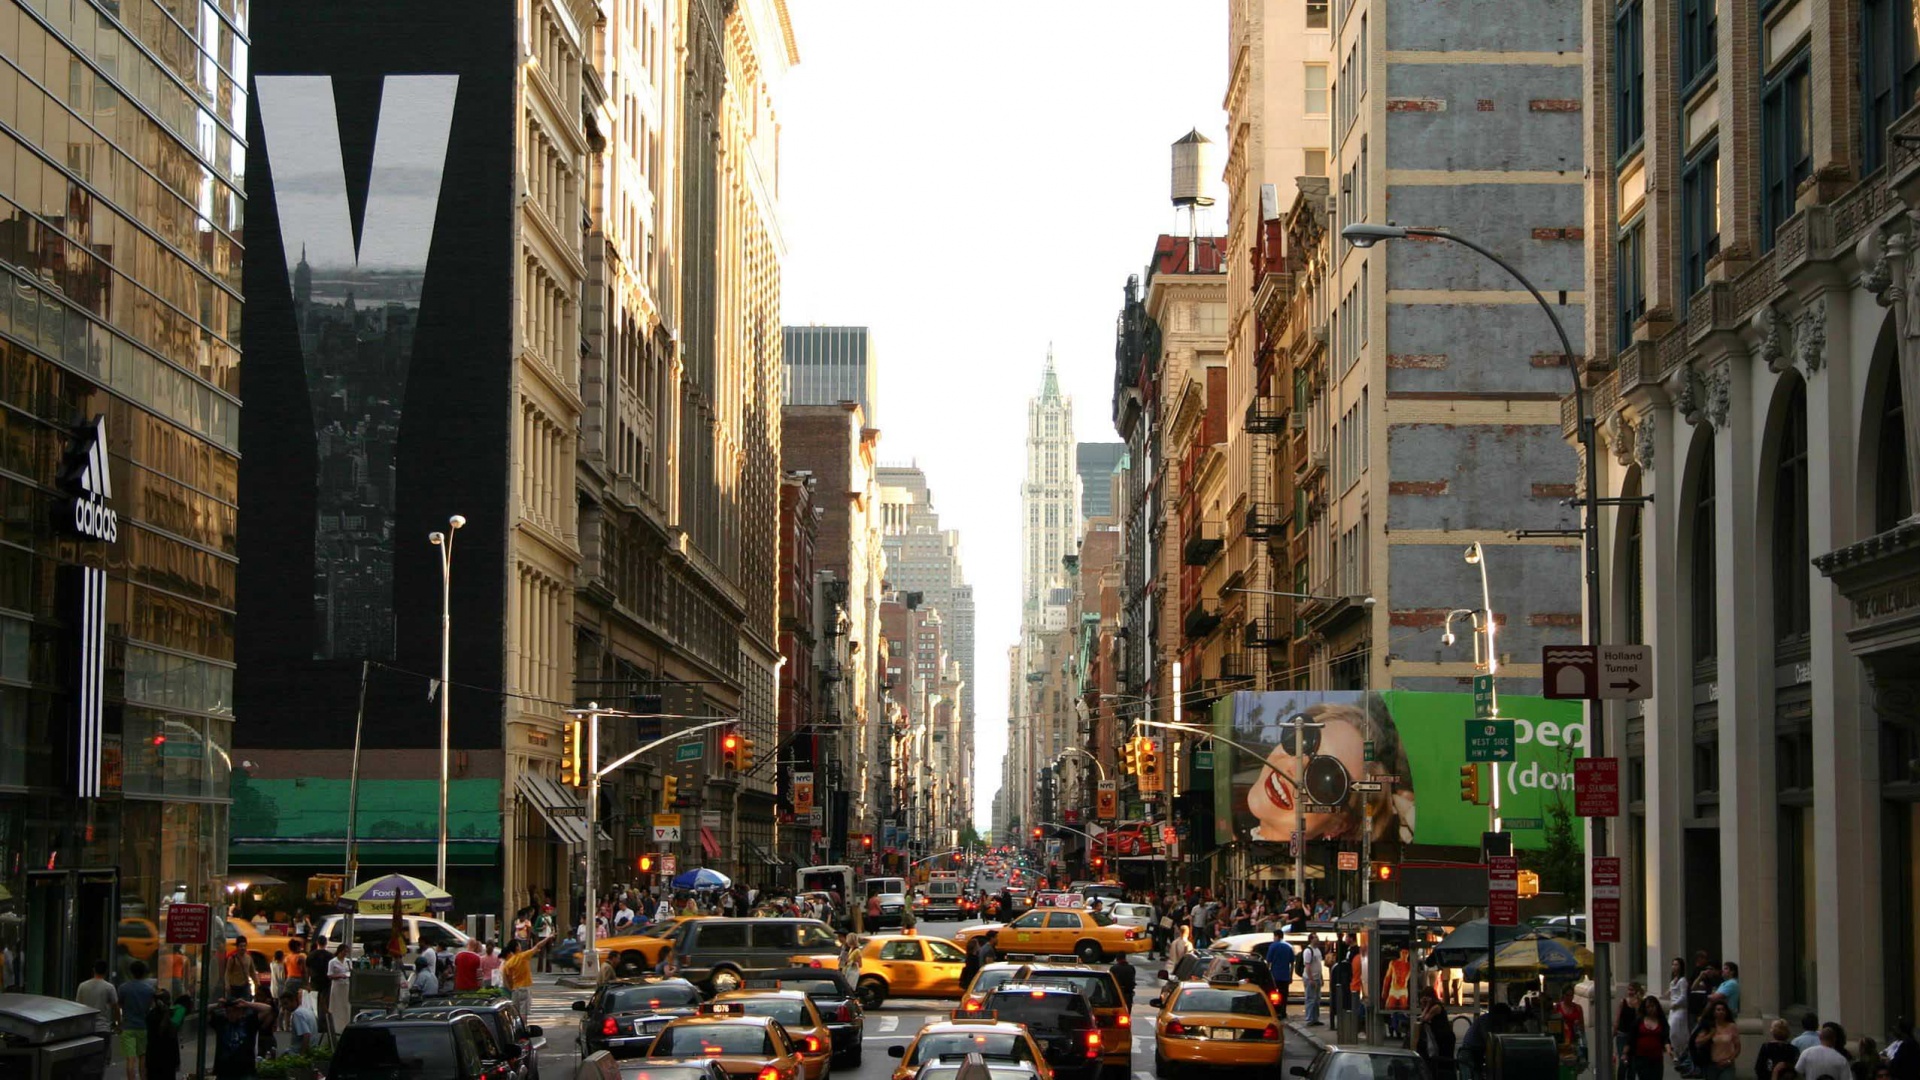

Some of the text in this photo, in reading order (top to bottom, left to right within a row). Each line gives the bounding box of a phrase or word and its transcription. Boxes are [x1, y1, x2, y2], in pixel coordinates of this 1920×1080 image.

[76, 492, 117, 543] adidas
[1604, 652, 1643, 660] Holland
[1605, 664, 1638, 673] Tunnel
[1471, 738, 1509, 746] WEST SIDE
[1472, 749, 1487, 757] HWY
[1576, 762, 1616, 770] SNOW ROUTE
[1576, 784, 1617, 793] NO STANDING
